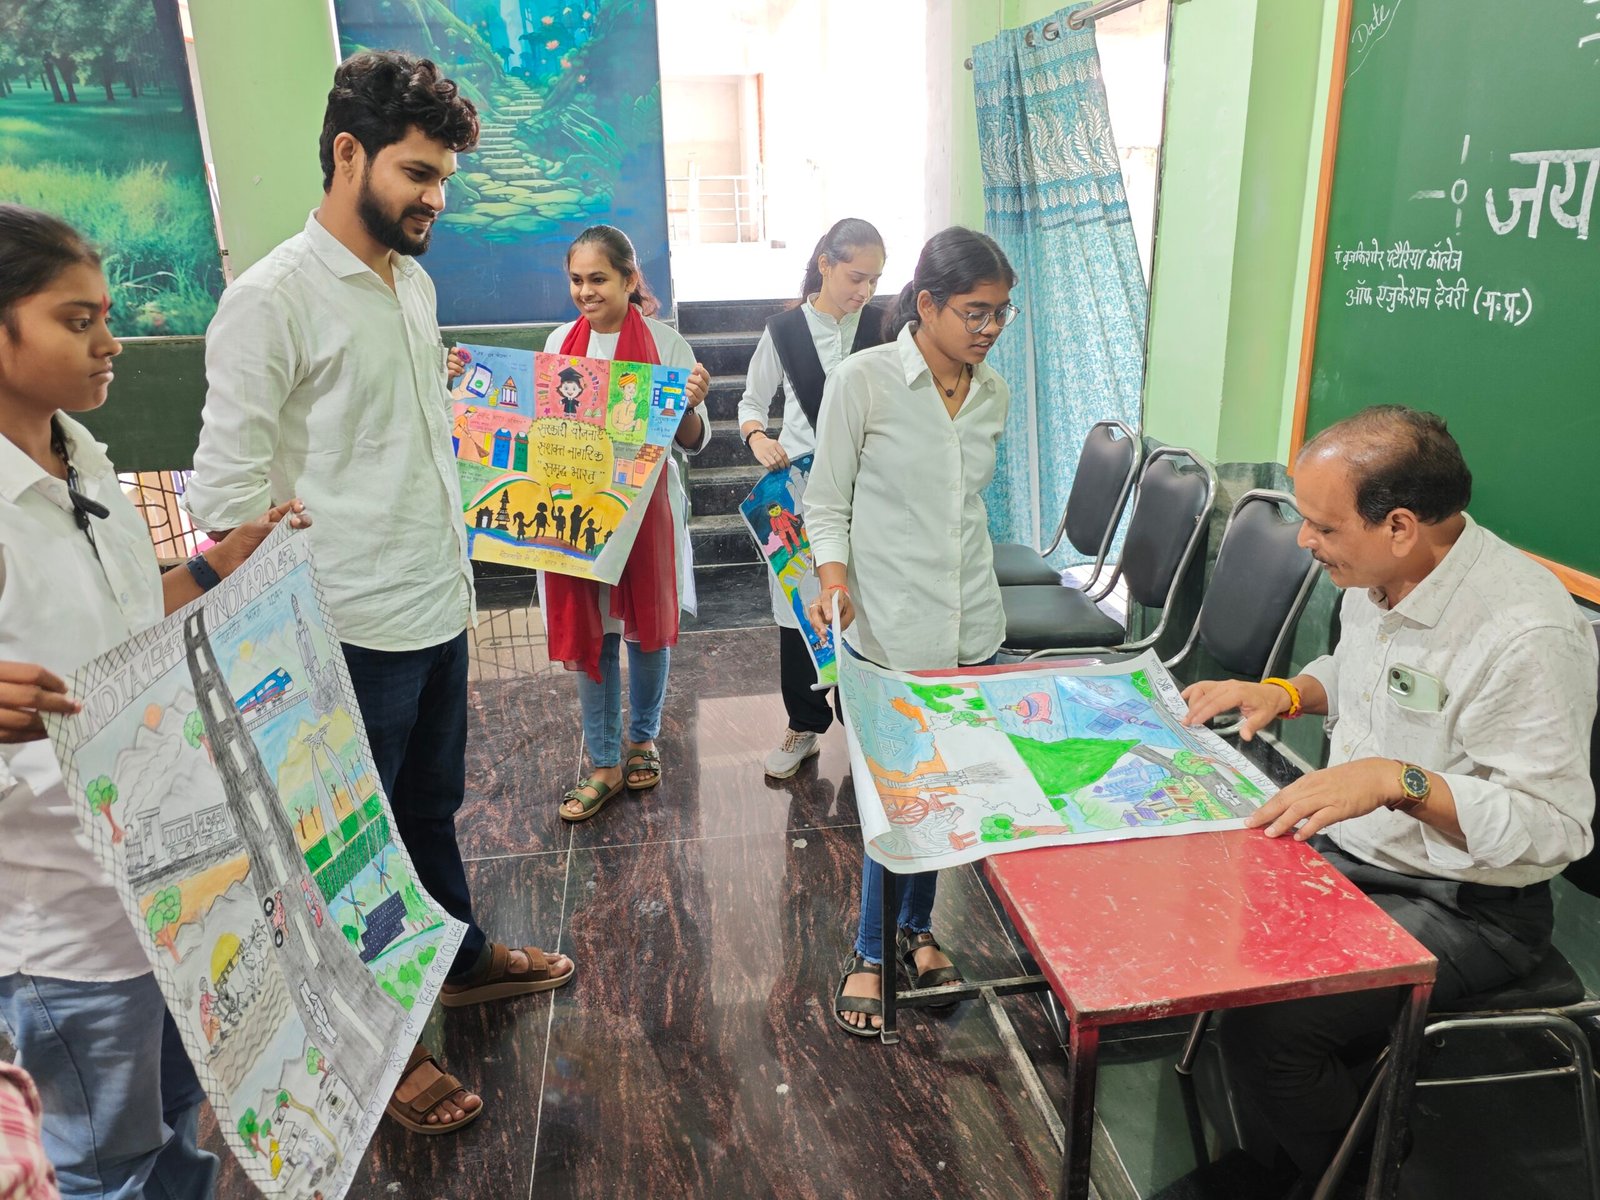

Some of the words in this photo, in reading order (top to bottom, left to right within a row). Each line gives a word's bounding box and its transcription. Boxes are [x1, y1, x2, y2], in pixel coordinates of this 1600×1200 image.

[1351, 3, 1391, 53] Date
[1485, 148, 1600, 240] जय
[1426, 237, 1463, 272] कॉलेज
[1345, 279, 1372, 307] ऑफ
[1376, 274, 1431, 313] एजुकेशन
[1434, 277, 1469, 310] देवरी
[567, 444, 604, 461] नागरिक
[1155, 676, 1173, 692] BKP
[416, 979, 441, 1007] YEAR
[439, 921, 465, 957] COLLEGE
